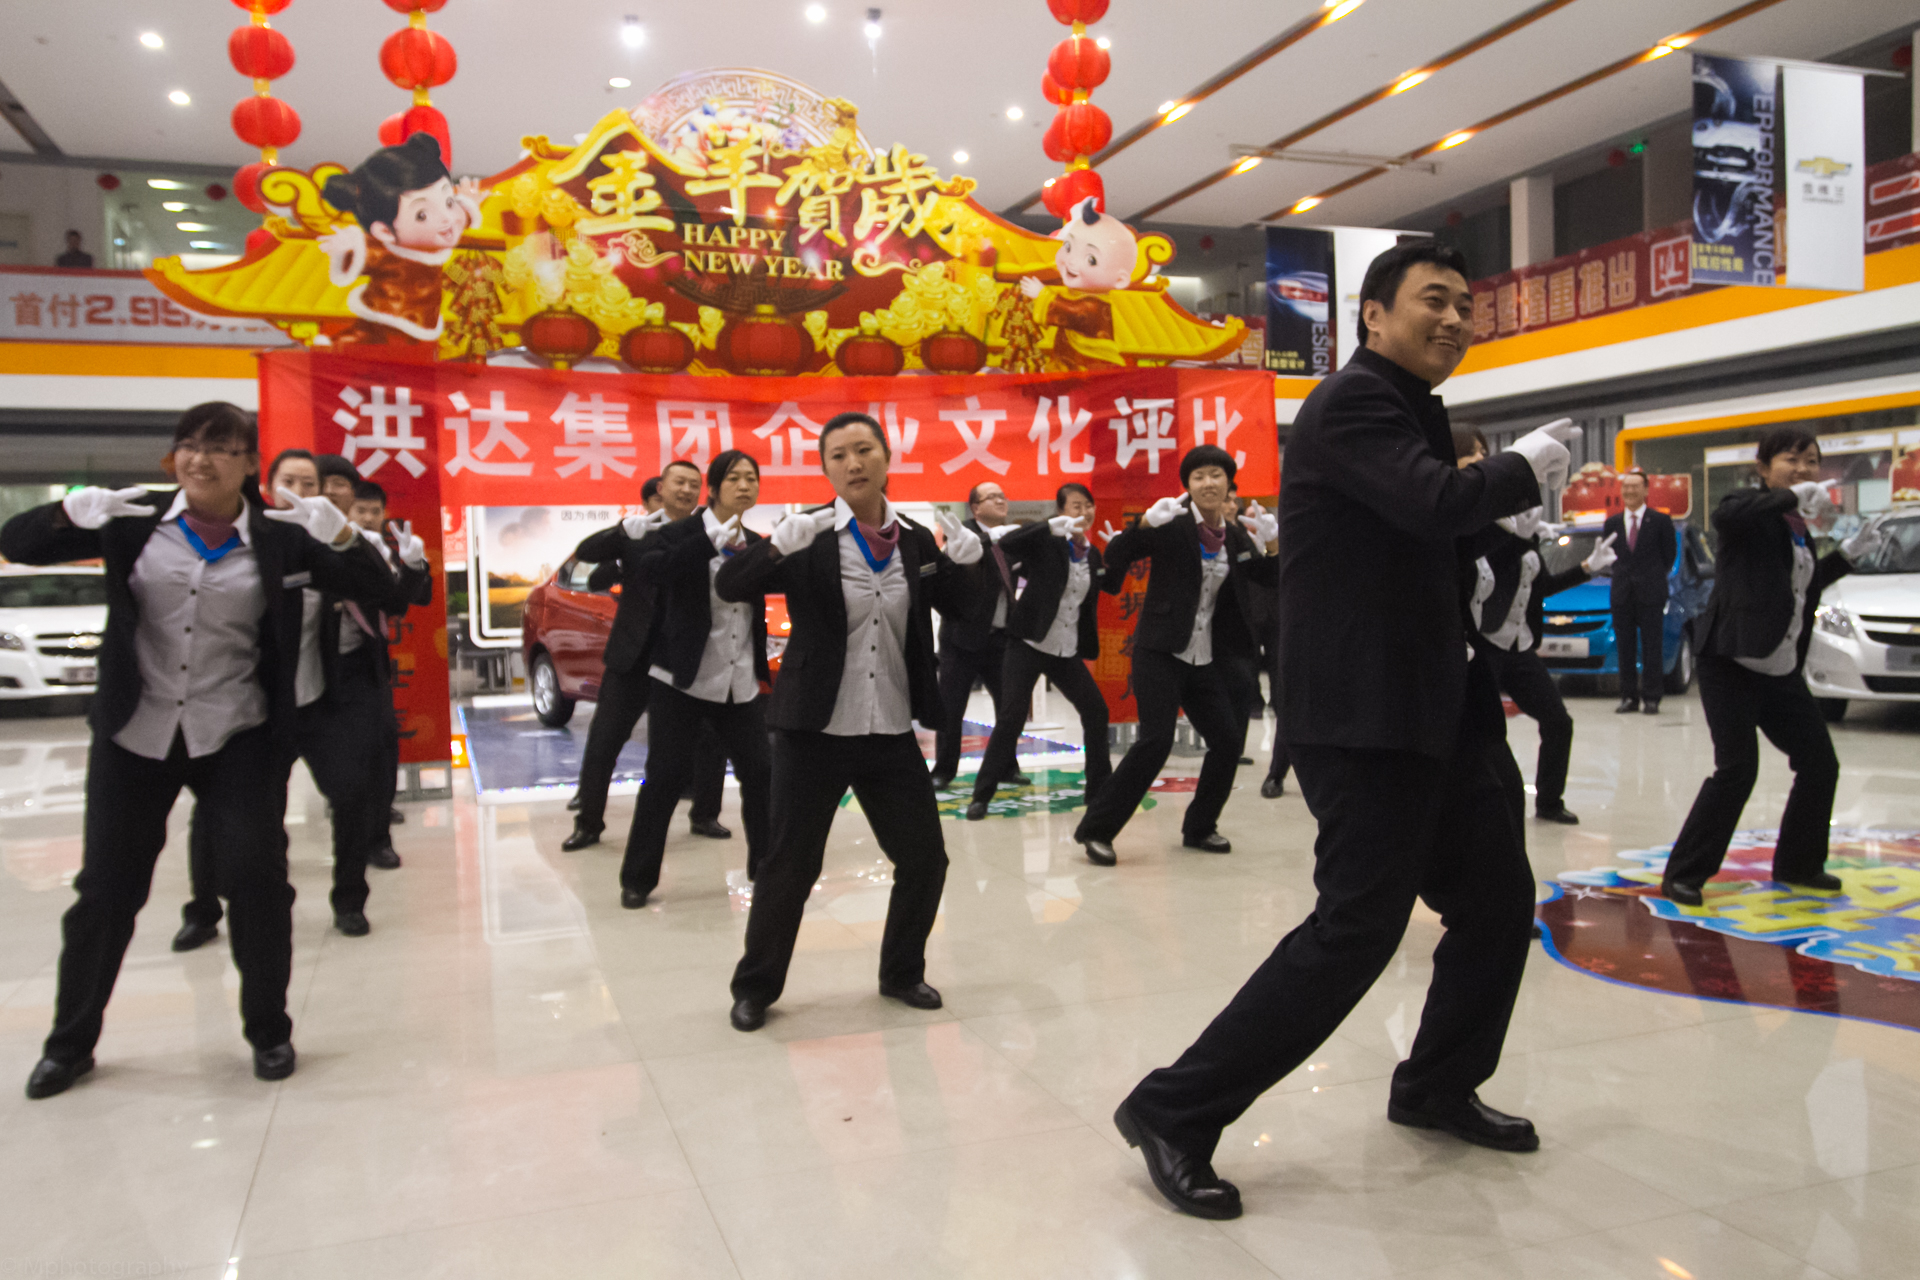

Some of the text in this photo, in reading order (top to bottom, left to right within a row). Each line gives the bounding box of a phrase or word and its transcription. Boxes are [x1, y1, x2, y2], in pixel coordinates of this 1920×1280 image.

[683, 223, 786, 252] HAPPY
[683, 250, 844, 281] NEW YEAR
[332, 385, 1246, 479] 洪达集团企业文化评比
